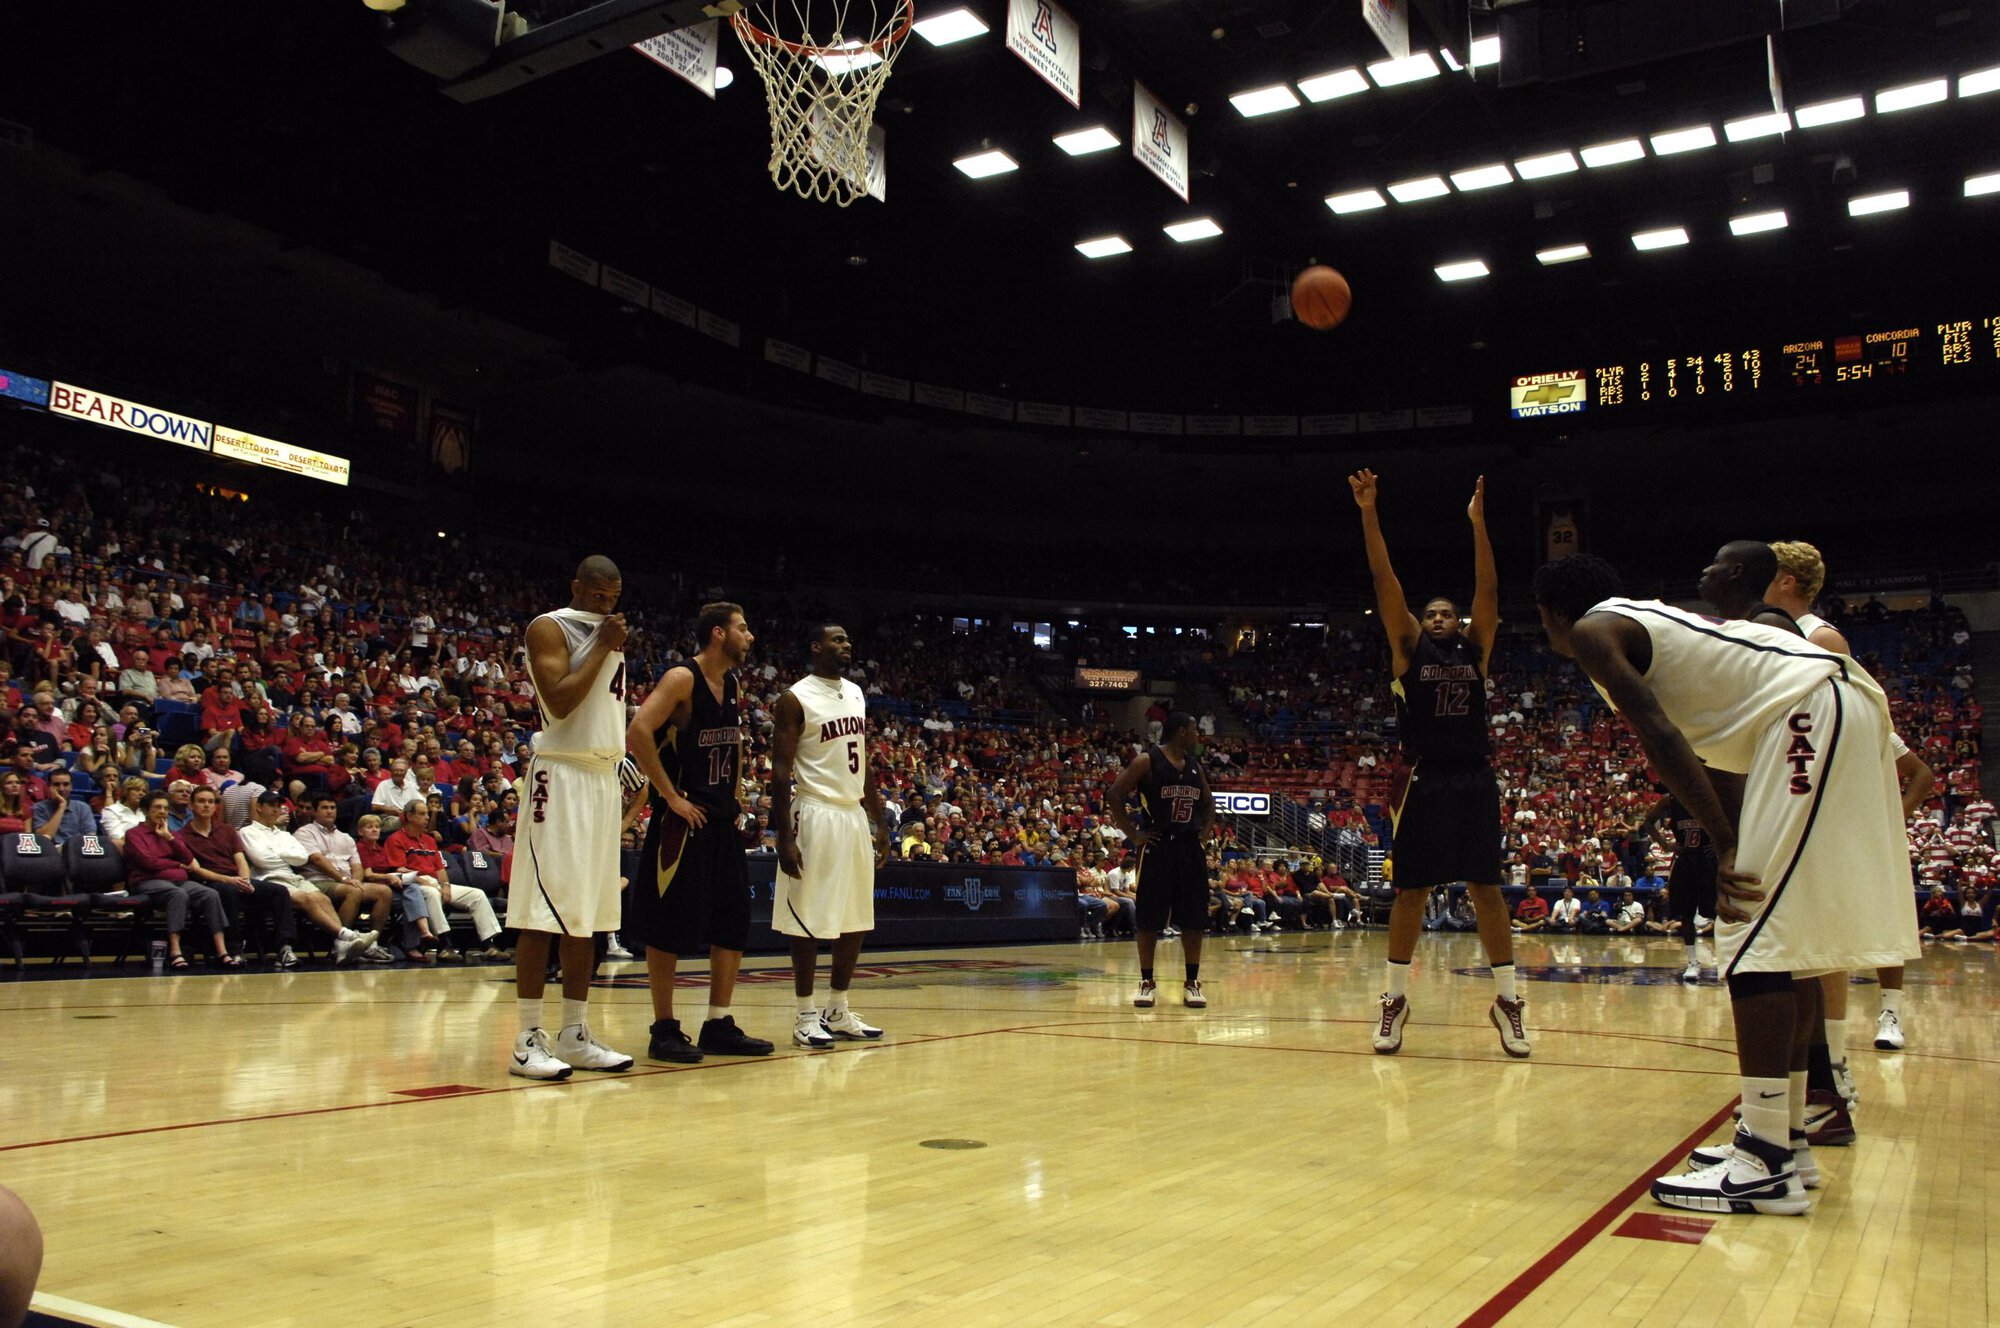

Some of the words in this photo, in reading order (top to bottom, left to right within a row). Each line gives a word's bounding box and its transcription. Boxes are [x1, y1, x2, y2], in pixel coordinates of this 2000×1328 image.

[1152, 107, 1171, 157] A
[1866, 328, 1919, 343] CONCORDIA
[1937, 320, 1972, 335] PLYR
[1944, 331, 1968, 344] PTS
[1783, 341, 1823, 354] ARIZONA
[1892, 342, 1906, 357] 10
[1943, 341, 1972, 355] RBS
[1596, 366, 1624, 378] PLYR
[1668, 360, 1676, 369] 5
[1686, 356, 1703, 367] 34
[1714, 353, 1731, 363] 42
[1742, 350, 1759, 360] 43
[1796, 354, 1816, 370] 24
[1943, 352, 1972, 365] FLS
[1516, 371, 1579, 386] O'RIELLY
[1836, 364, 1872, 381] 5:54
[1601, 376, 1621, 386] PTS
[1600, 385, 1623, 396] RBS
[1518, 402, 1580, 417] WATSON
[216, 434, 245, 448] DESERT
[249, 443, 279, 457] TOYOTA
[289, 454, 317, 466] DESERT
[320, 461, 348, 475] TOYOTA
[1553, 530, 1572, 544] 32
[609, 662, 624, 702] 4
[1434, 680, 1470, 717] 12
[847, 741, 859, 774] 5
[1787, 713, 1816, 794] CATS
[708, 746, 732, 786] 14
[532, 770, 548, 823] CATS
[1172, 797, 1194, 823] 15
[17, 834, 41, 854] A
[82, 836, 104, 855] A
[472, 852, 488, 868] A
